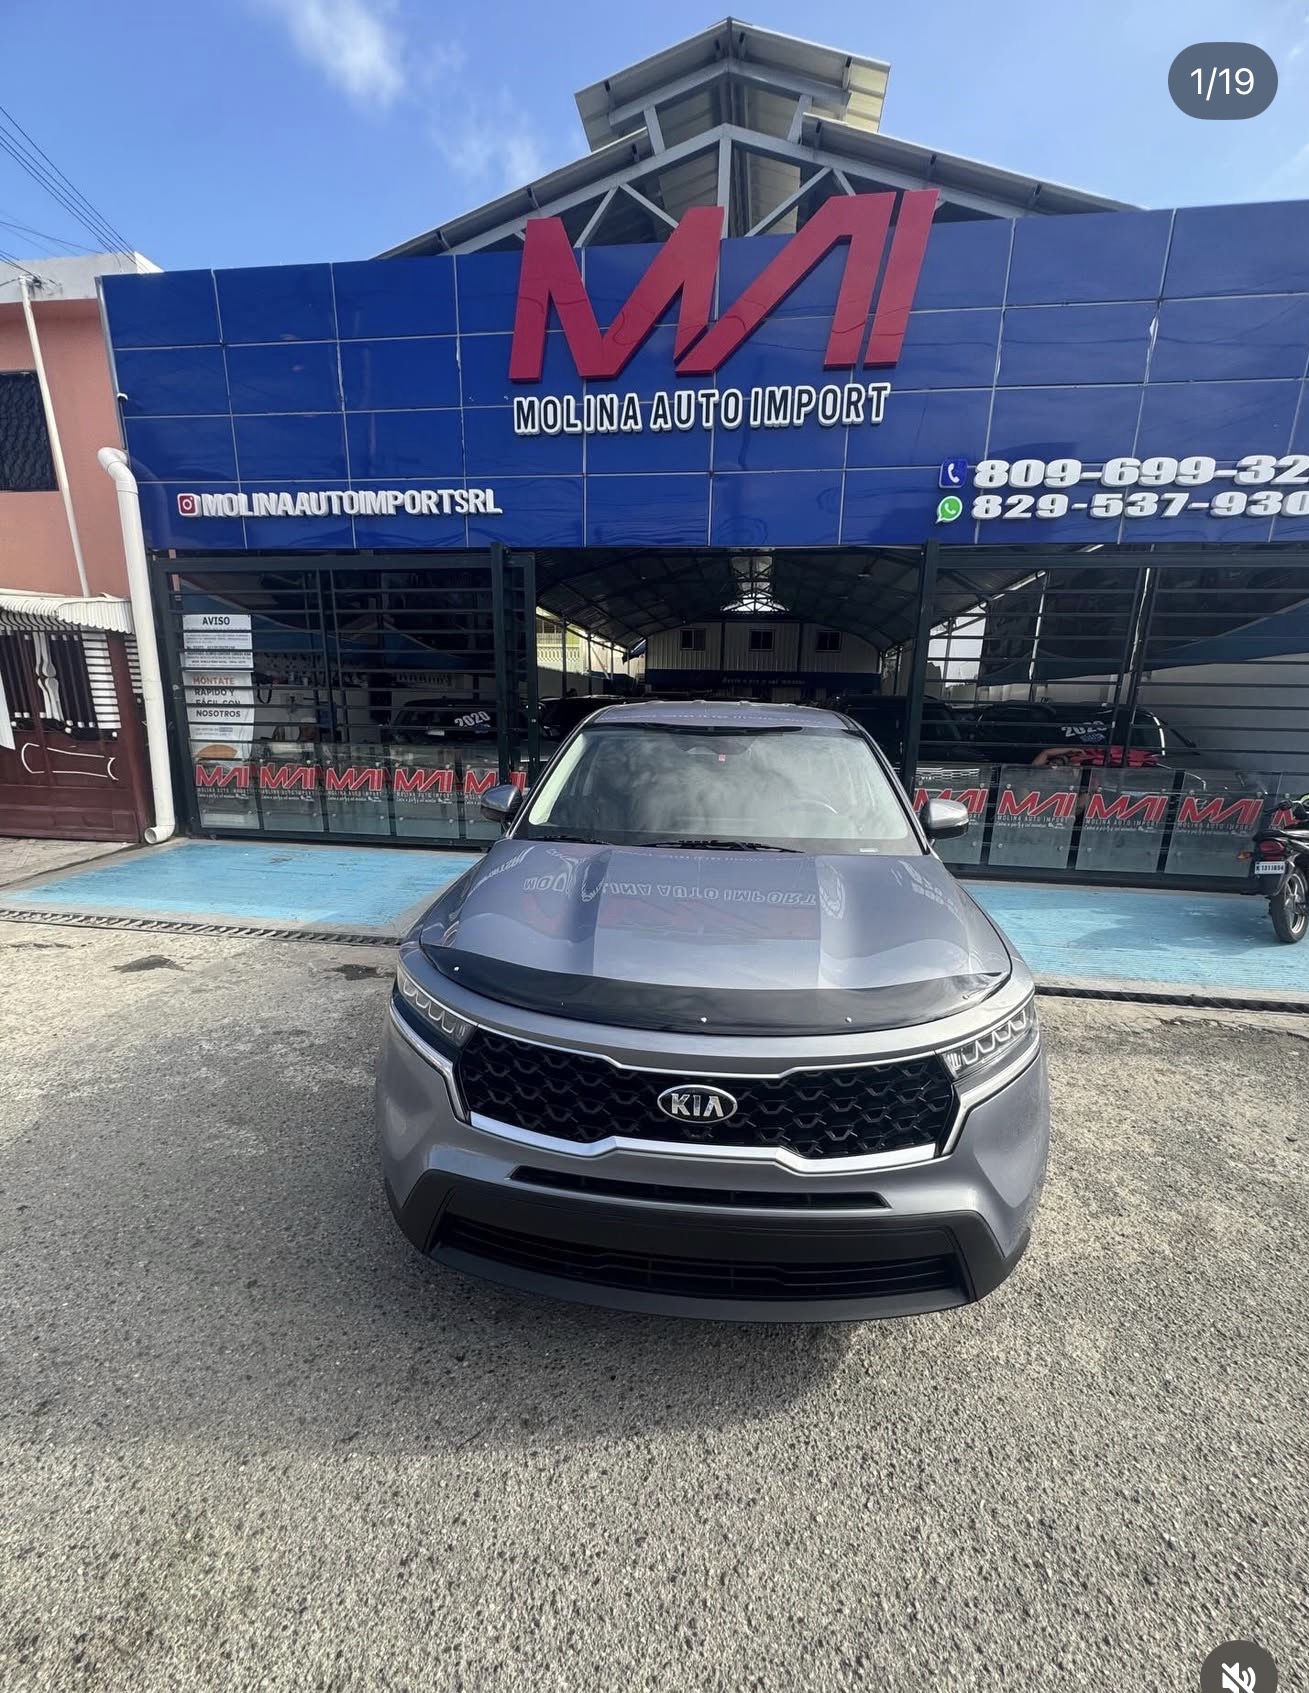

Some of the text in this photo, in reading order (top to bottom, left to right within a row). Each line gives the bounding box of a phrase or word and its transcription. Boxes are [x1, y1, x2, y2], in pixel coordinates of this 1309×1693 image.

[513, 382, 892, 435] MOLINA AUTO IMPORT
[973, 454, 1309, 488] 809-699-32
[200, 489, 503, 517] MOLINAAUTOIMPORTSRL
[971, 490, 1309, 519] 829-537-930
[202, 616, 231, 626] AVISO
[228, 688, 235, 697] Y
[671, 1092, 725, 1118] KIA
